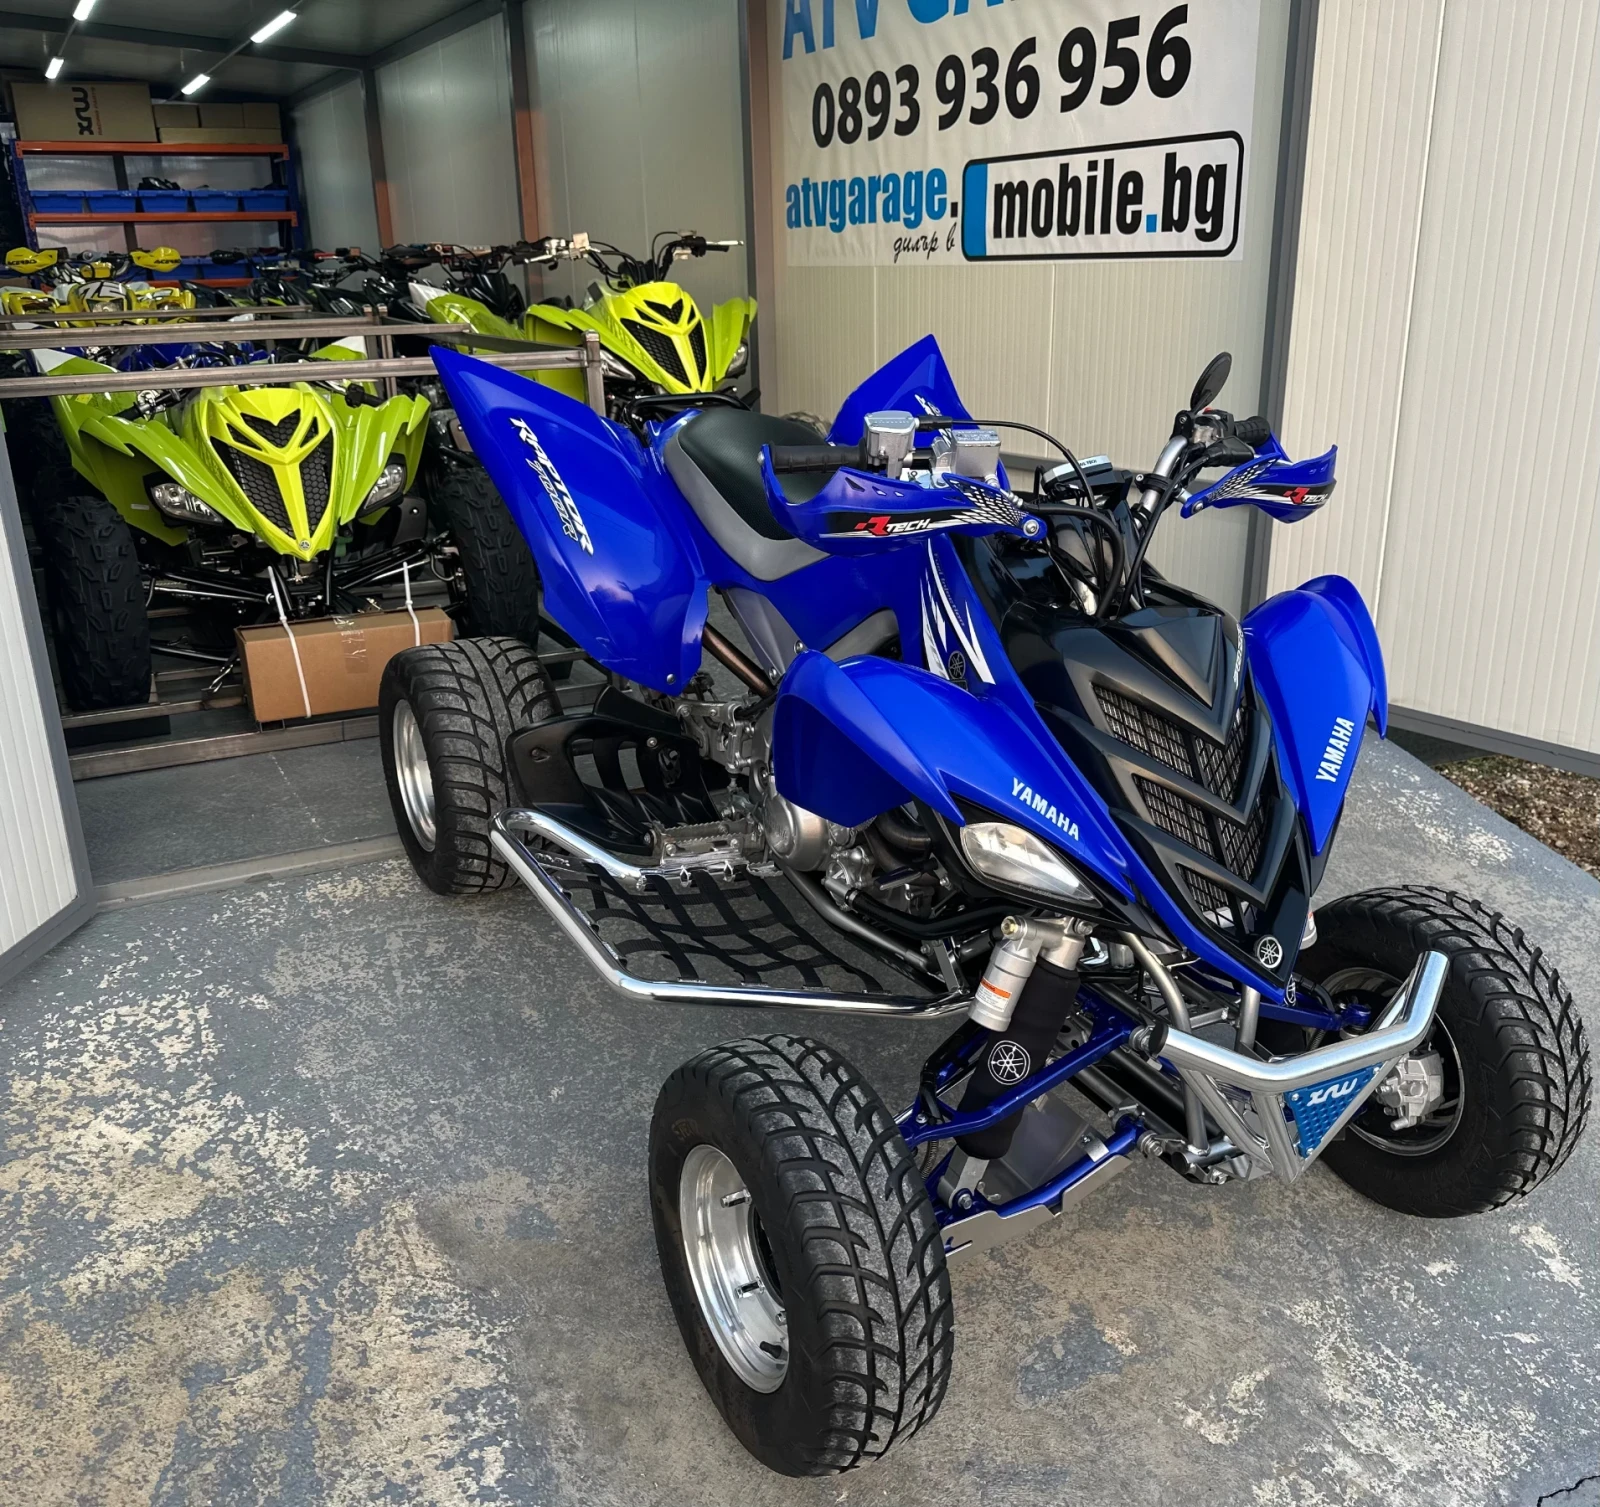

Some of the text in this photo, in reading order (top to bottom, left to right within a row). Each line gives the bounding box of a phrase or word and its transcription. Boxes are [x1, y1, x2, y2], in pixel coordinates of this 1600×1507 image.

[812, 3, 1192, 148] 0893 936 956
[992, 151, 1229, 243] mobile.bg
[509, 417, 595, 556] RAPTOR
[525, 457, 579, 542] 700R
[1315, 716, 1355, 783] YAMAHA
[1011, 776, 1079, 841] YAMAHA
